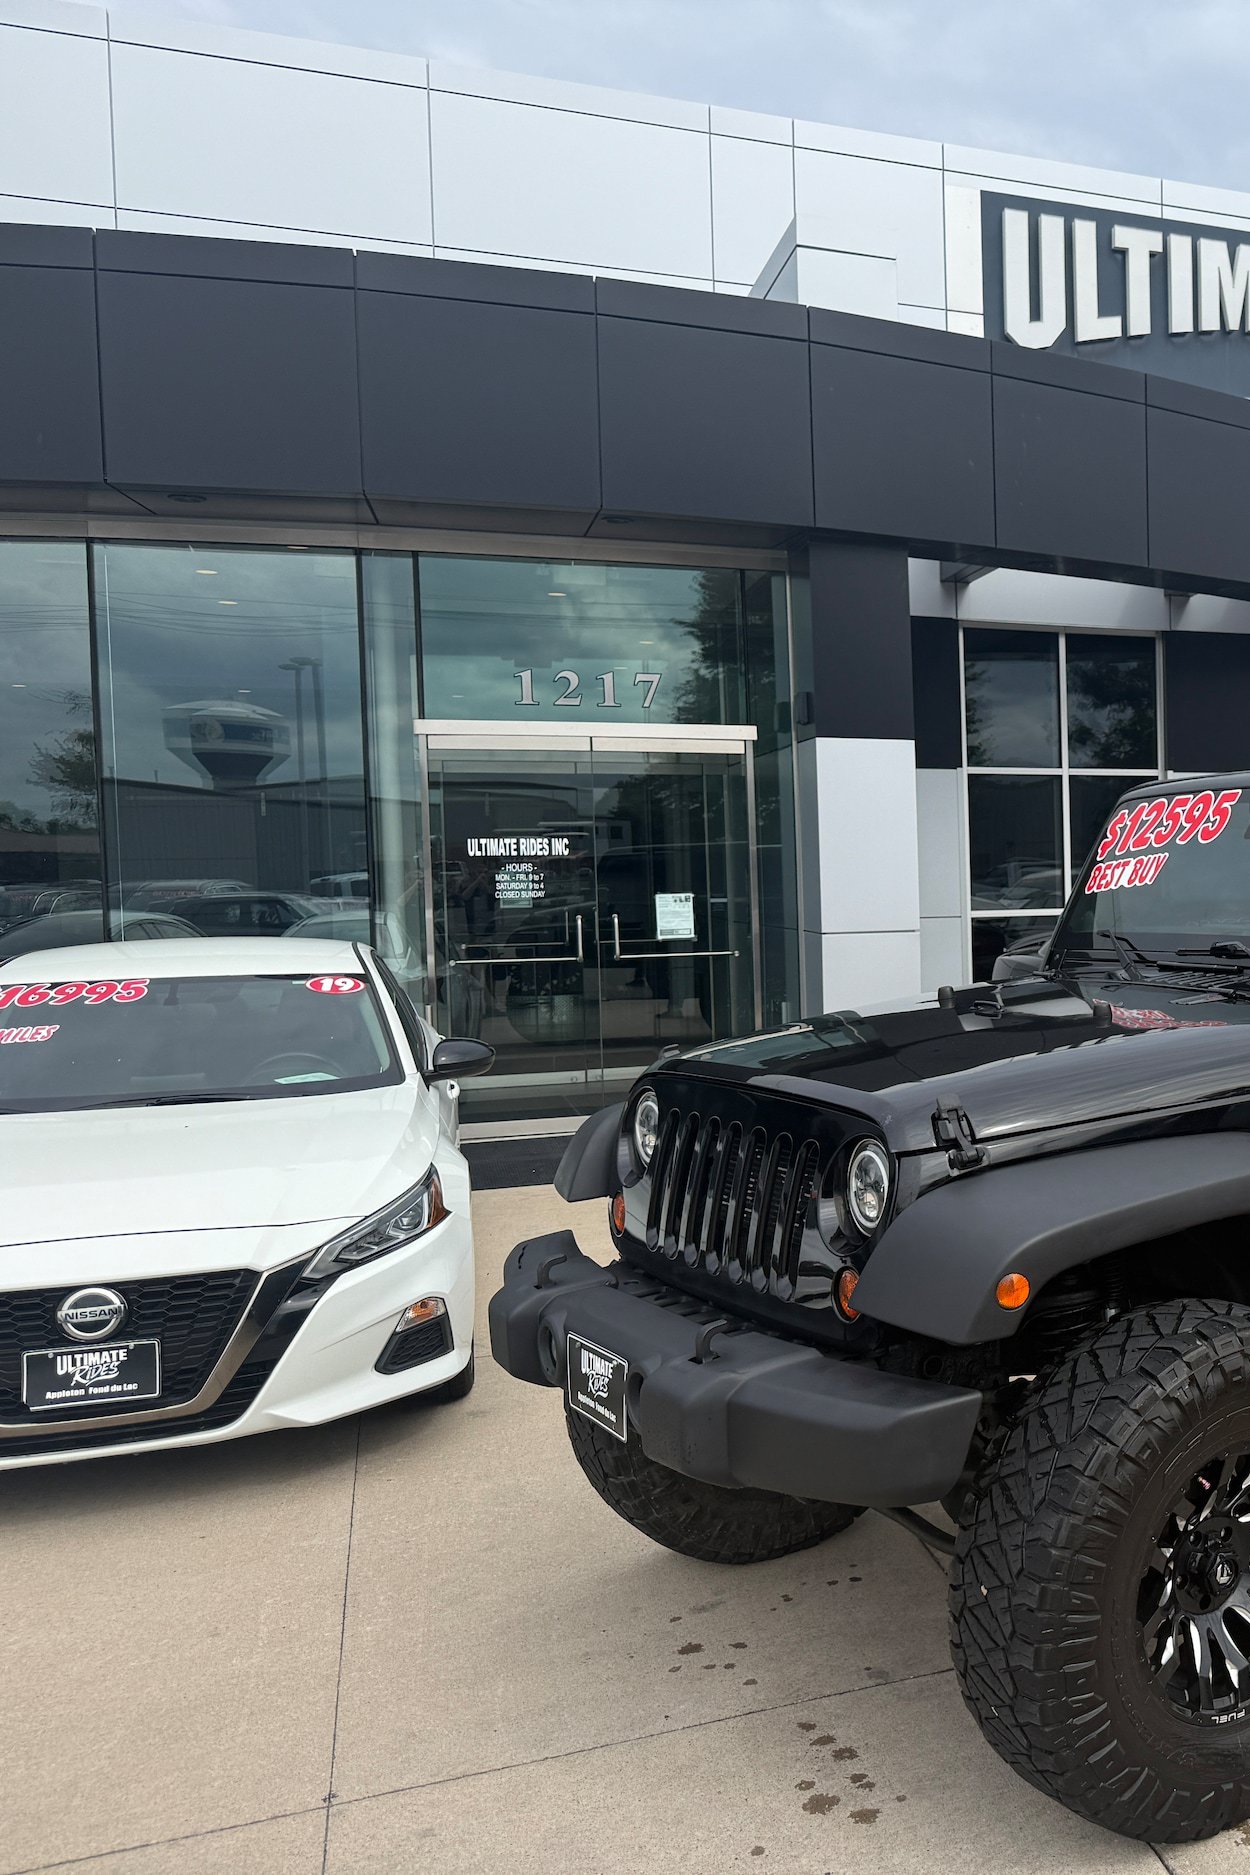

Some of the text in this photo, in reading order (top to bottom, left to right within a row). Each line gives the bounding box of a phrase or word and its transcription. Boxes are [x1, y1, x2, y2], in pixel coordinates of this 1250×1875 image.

[514, 669, 662, 708] 1217
[1097, 789, 1242, 861] $12595
[467, 838, 569, 856] ULTIMATE RIDES INC
[505, 863, 533, 872] HOURS
[1085, 853, 1169, 894] BEST BUY
[540, 873, 544, 881] 7
[496, 882, 528, 890] SATURDAY
[533, 882, 540, 890] to
[320, 977, 355, 992] 19
[0, 978, 150, 1009] 16995
[64, 1307, 118, 1321] NISSAN
[56, 1349, 128, 1376] ULTIMATE
[581, 1348, 614, 1379] ULTIMATE
[46, 1383, 138, 1400] Appleton Fond du Lac
[1211, 1709, 1245, 1724] FUEL
